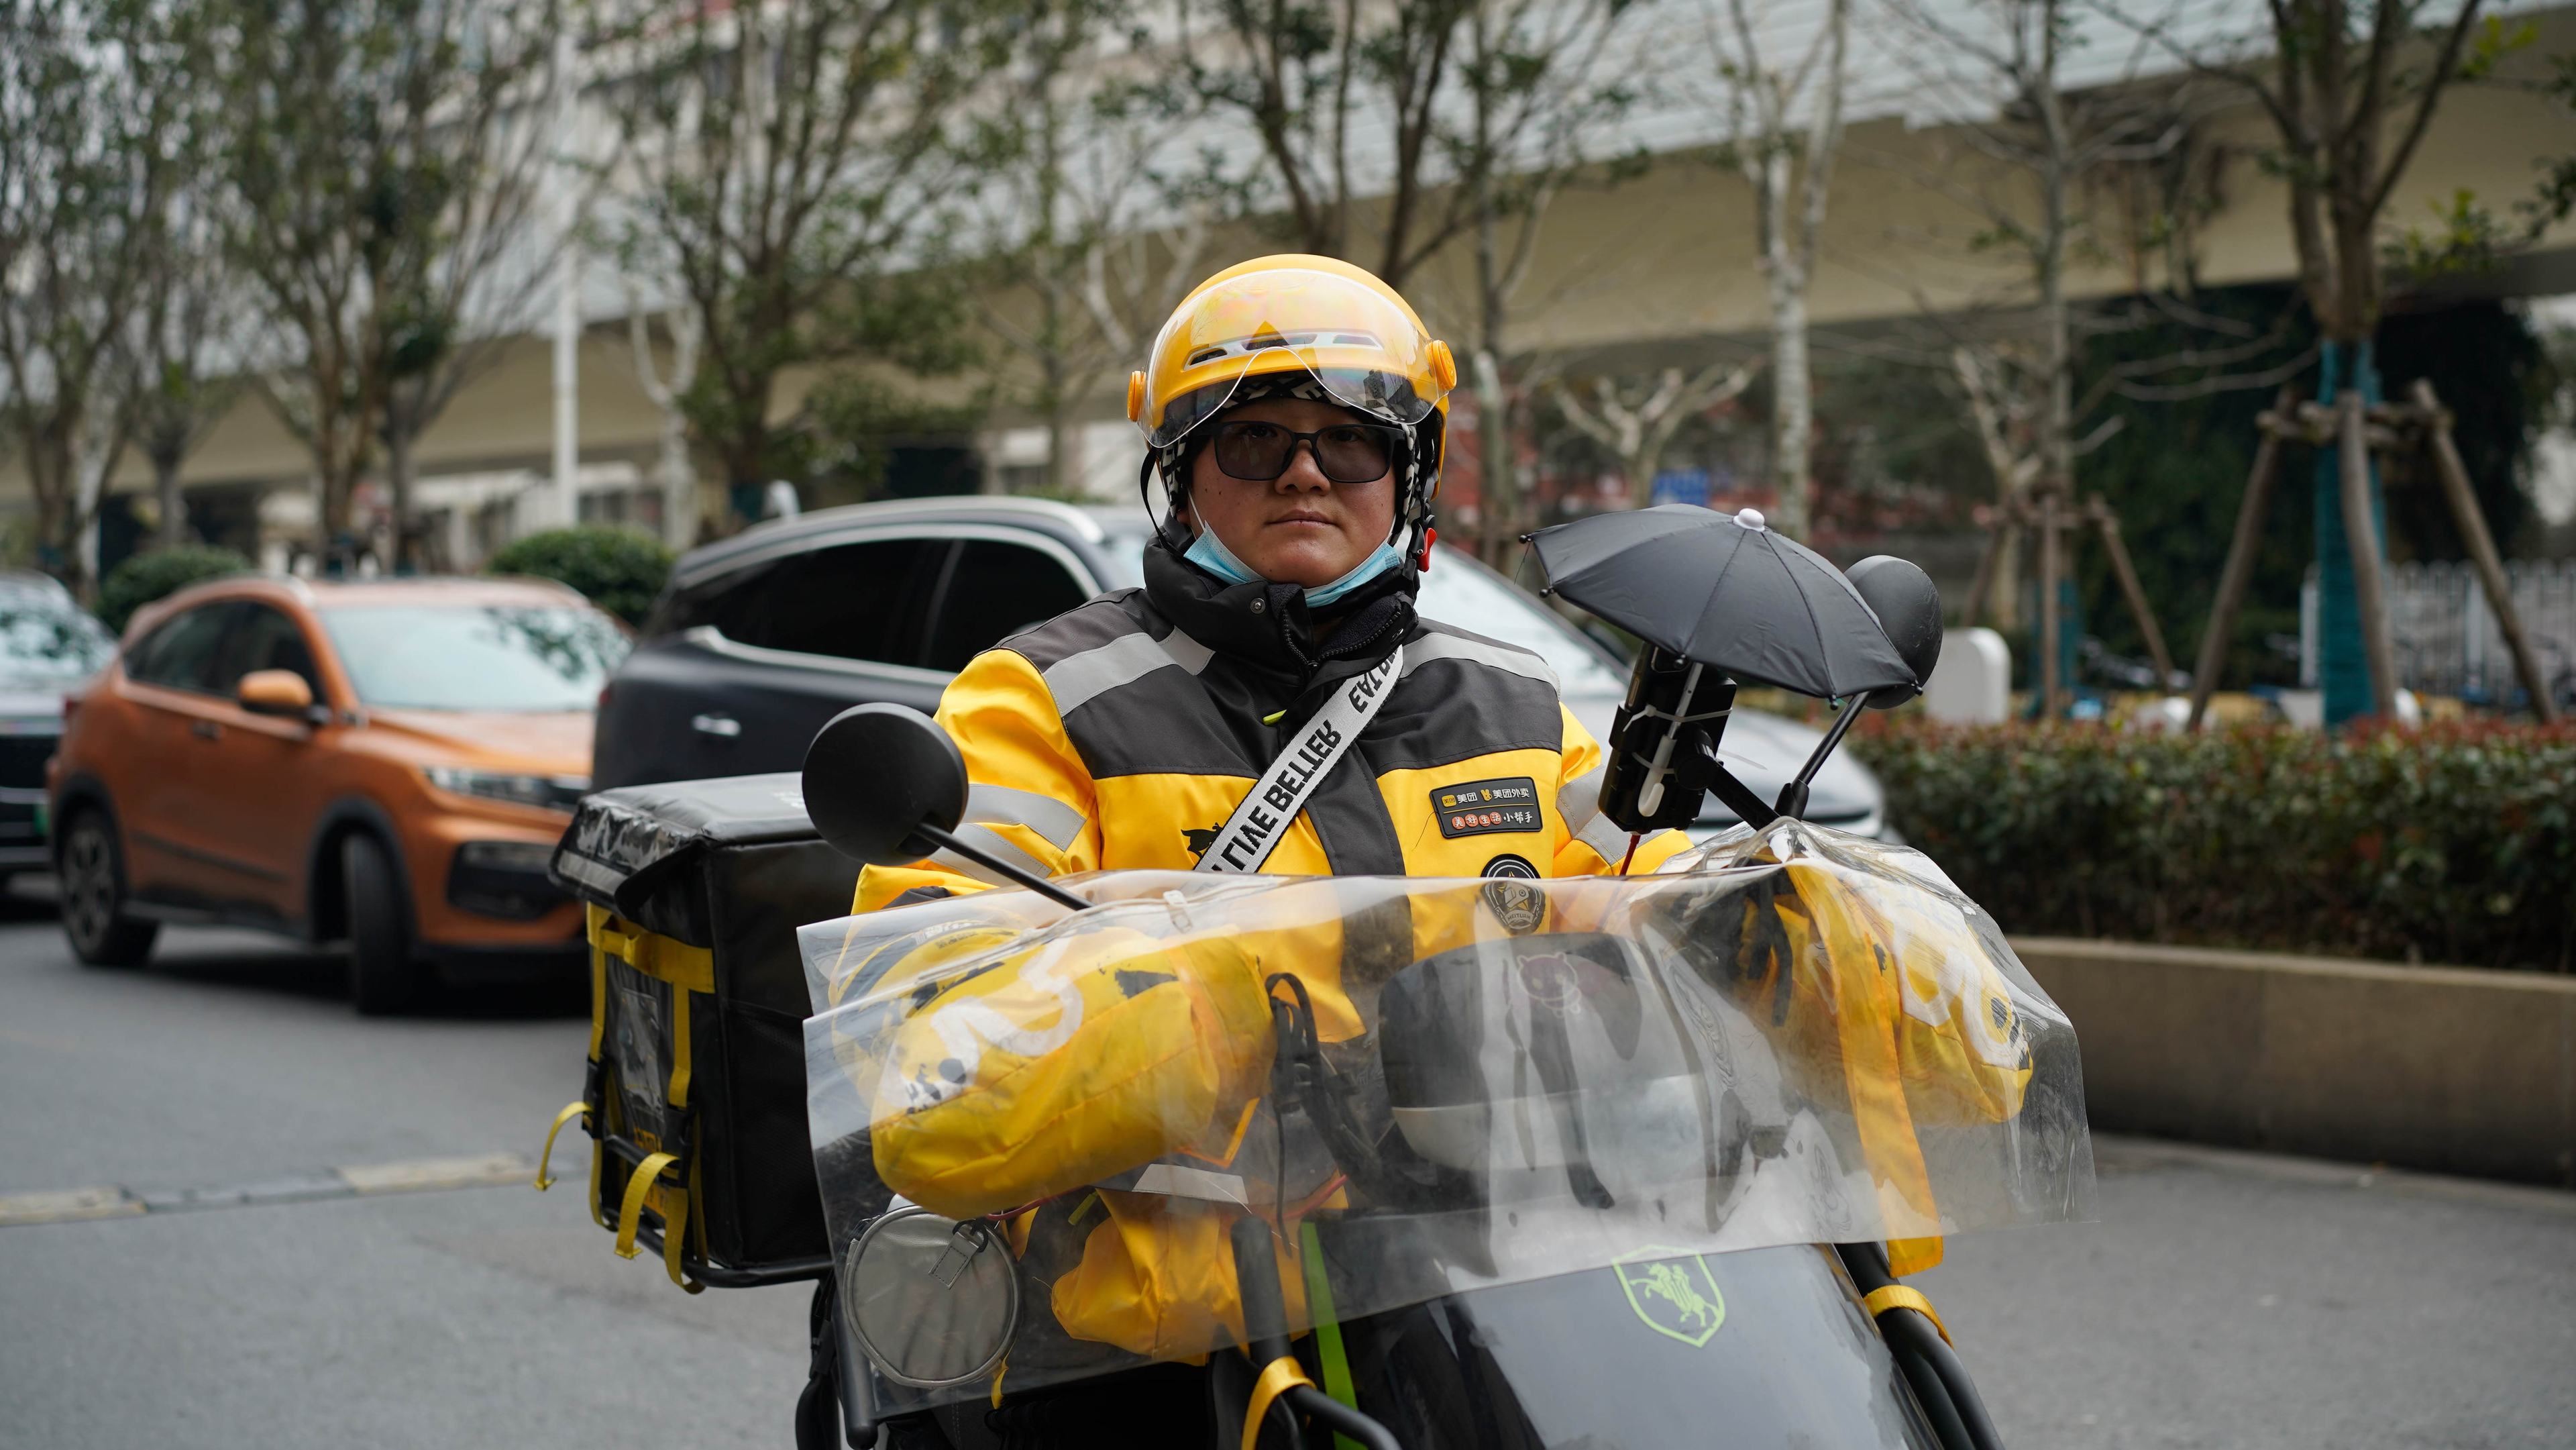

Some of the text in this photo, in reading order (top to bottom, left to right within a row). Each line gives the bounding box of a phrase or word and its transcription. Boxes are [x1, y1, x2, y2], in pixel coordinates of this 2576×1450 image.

[1456, 792, 1478, 804] 美团
[1492, 788, 1530, 798] 美团外卖
